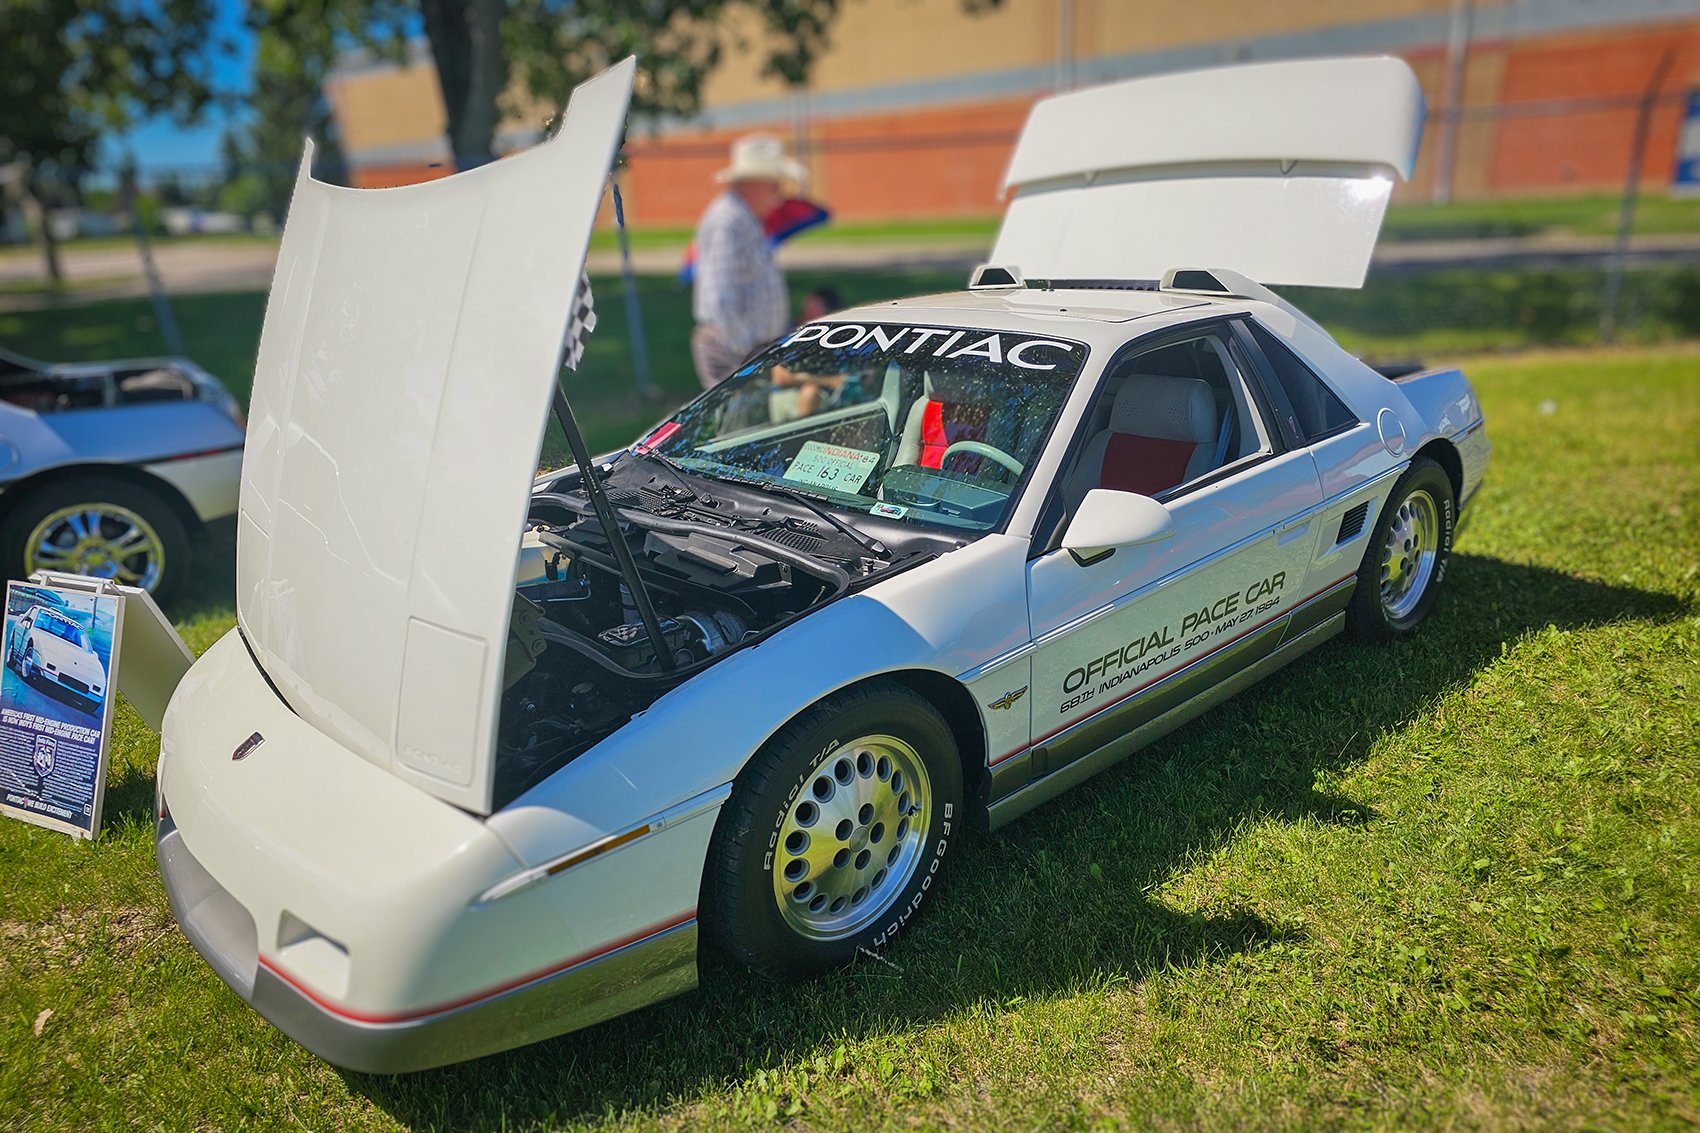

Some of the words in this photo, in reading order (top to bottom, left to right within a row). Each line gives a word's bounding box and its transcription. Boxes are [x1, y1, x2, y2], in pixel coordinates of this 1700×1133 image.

[780, 324, 1073, 371] PONTIAC
[794, 462, 814, 473] PACE
[816, 465, 840, 480] 163
[844, 473, 862, 484] CAR
[823, 447, 860, 460] INDIANA
[827, 458, 853, 469] OFFICIAL
[1062, 626, 1175, 694] OFFICIAL
[1180, 591, 1241, 638] PACE
[1245, 571, 1287, 605] CAR
[1099, 646, 1181, 695] INDIANAPOLIS
[1184, 630, 1210, 651] 500
[1214, 616, 1239, 636] MAY
[1255, 596, 1280, 616] 1984
[90, 729, 101, 739] CAR
[763, 774, 805, 871] Radial
[809, 738, 840, 768] T/A
[873, 803, 954, 947] BFGoodrich
